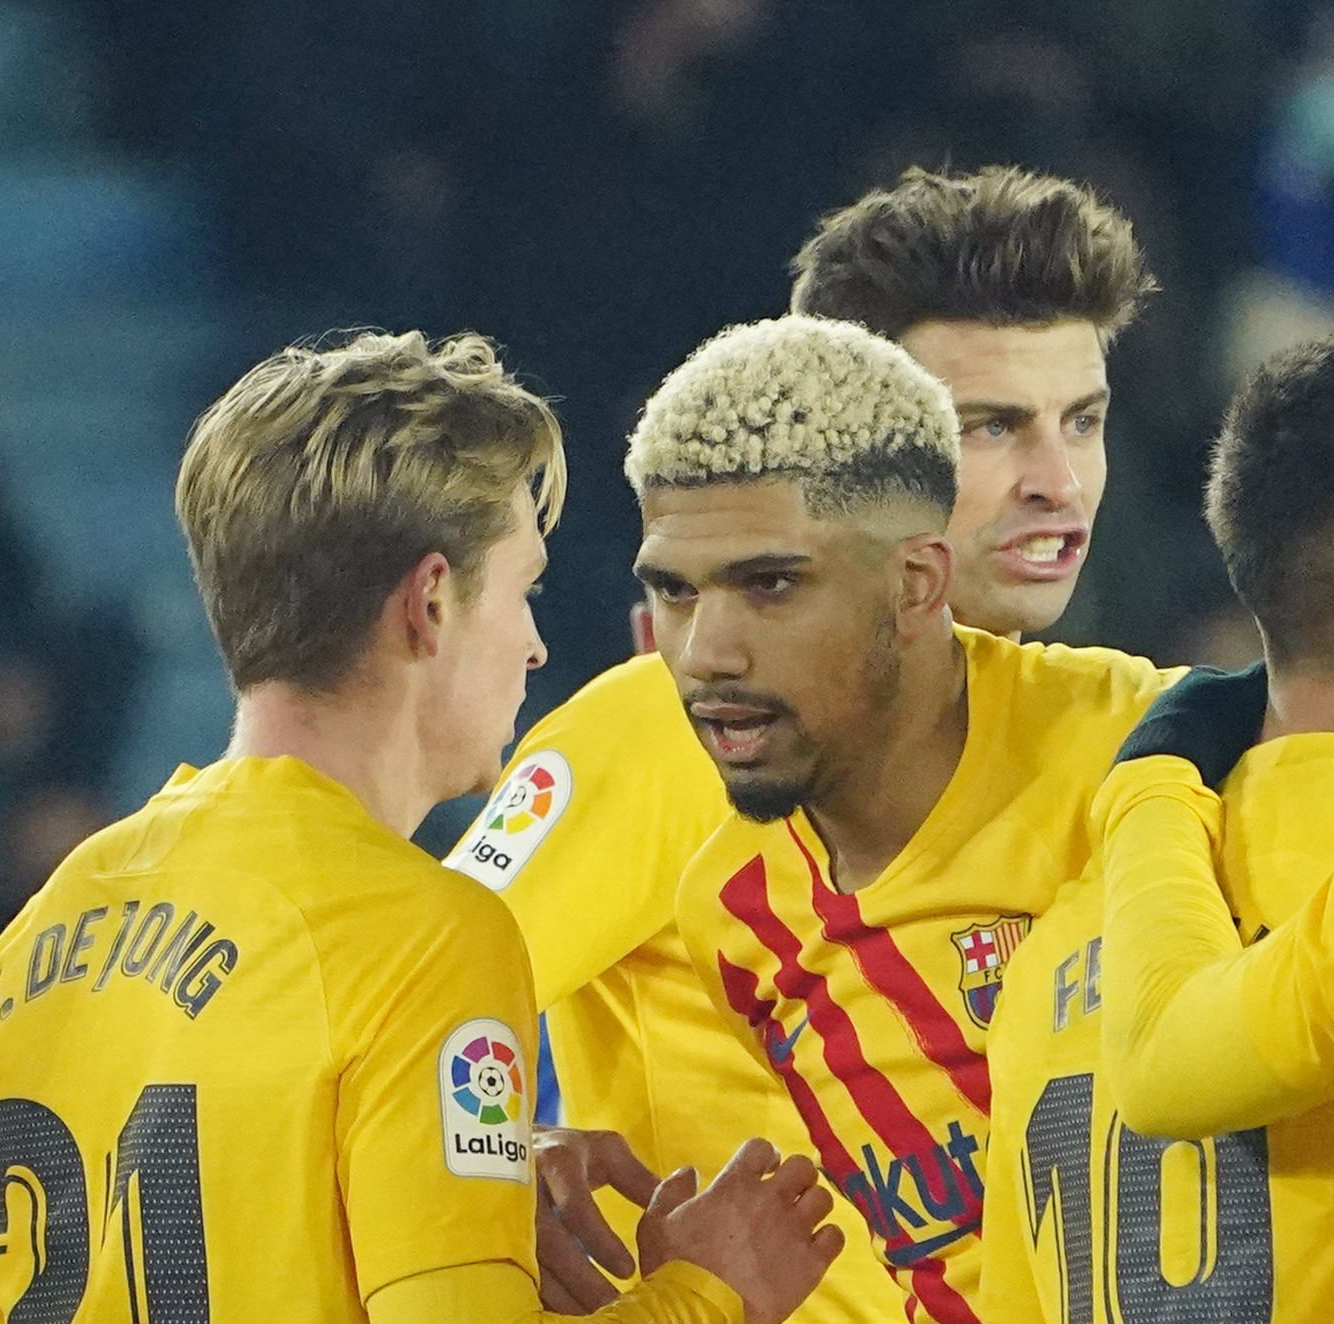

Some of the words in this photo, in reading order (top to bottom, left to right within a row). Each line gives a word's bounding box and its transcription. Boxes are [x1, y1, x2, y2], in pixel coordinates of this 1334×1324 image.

[25, 905, 110, 1004] DE
[91, 899, 240, 1020] JONG
[454, 1132, 528, 1163] LaLiga
